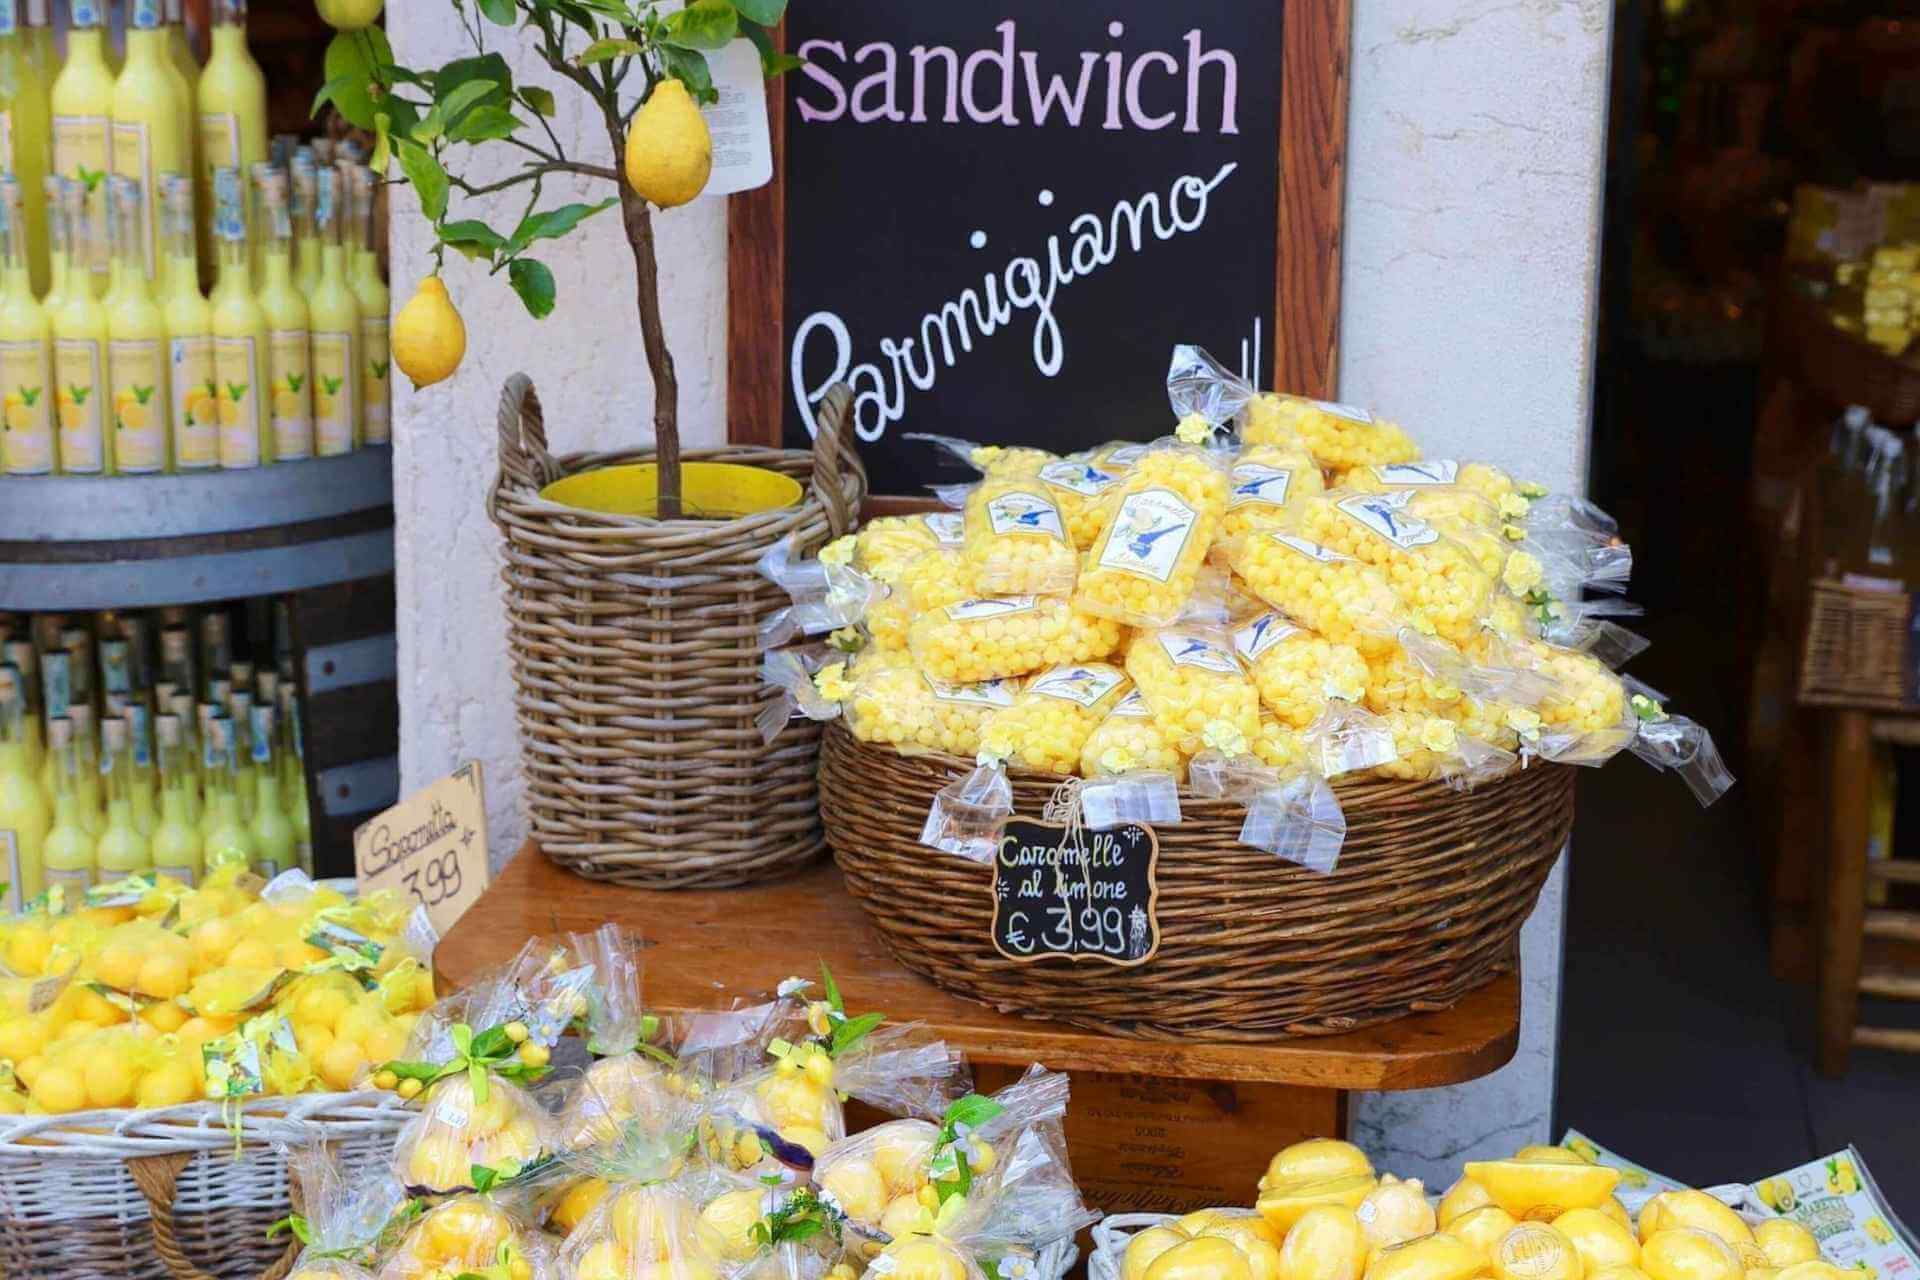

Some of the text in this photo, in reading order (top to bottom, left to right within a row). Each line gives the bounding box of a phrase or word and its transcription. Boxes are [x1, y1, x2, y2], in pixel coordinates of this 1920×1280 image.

[797, 19, 1239, 135] sandwich
[791, 163, 1238, 443] Parmigiano
[1000, 834, 1125, 868] Caramelle
[1018, 869, 1044, 898] al
[1004, 911, 1035, 953] €
